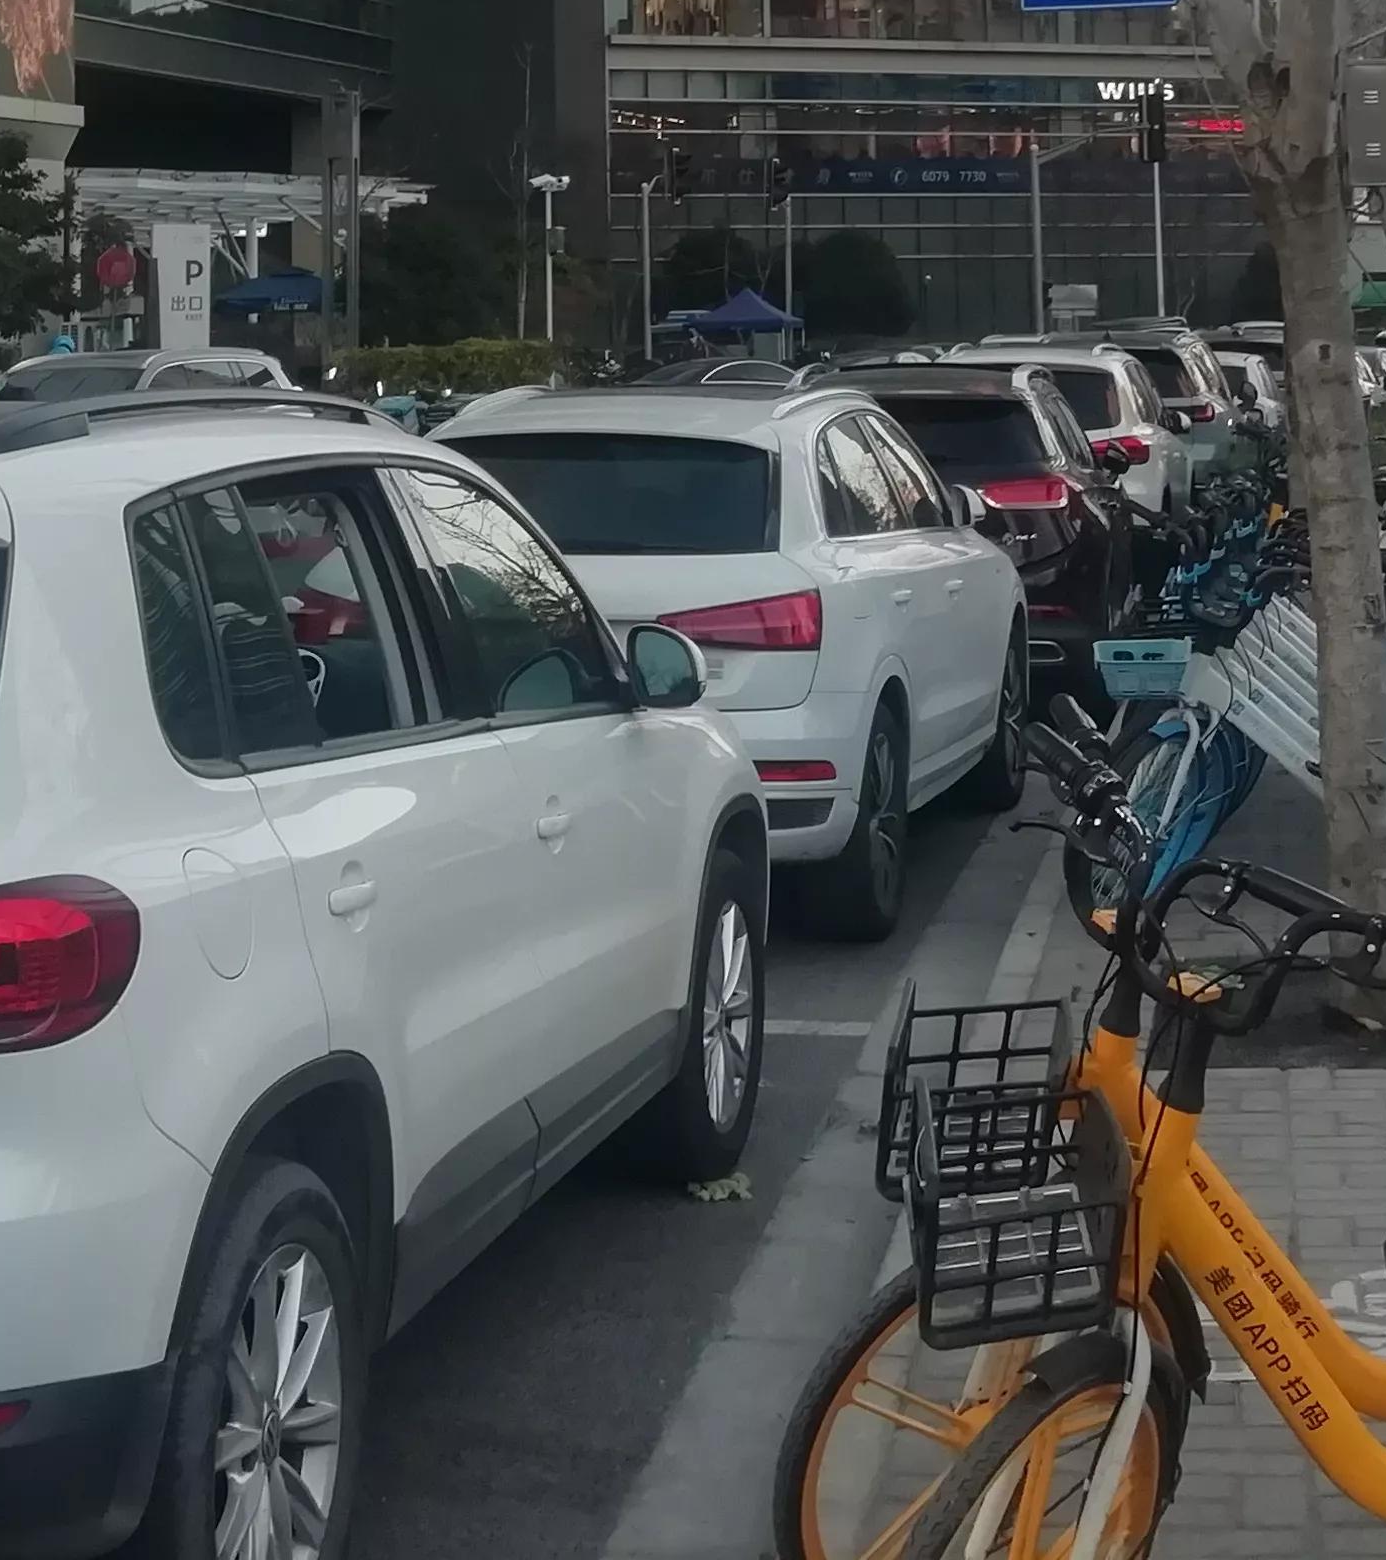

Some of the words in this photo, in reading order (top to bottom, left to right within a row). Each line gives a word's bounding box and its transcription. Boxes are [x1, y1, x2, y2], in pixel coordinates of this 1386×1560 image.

[921, 170, 950, 183] 6079
[959, 170, 987, 183] 7730
[186, 260, 203, 286] P
[171, 295, 203, 312] 出口
[1205, 1265, 1330, 1431] 美团APP扫码
